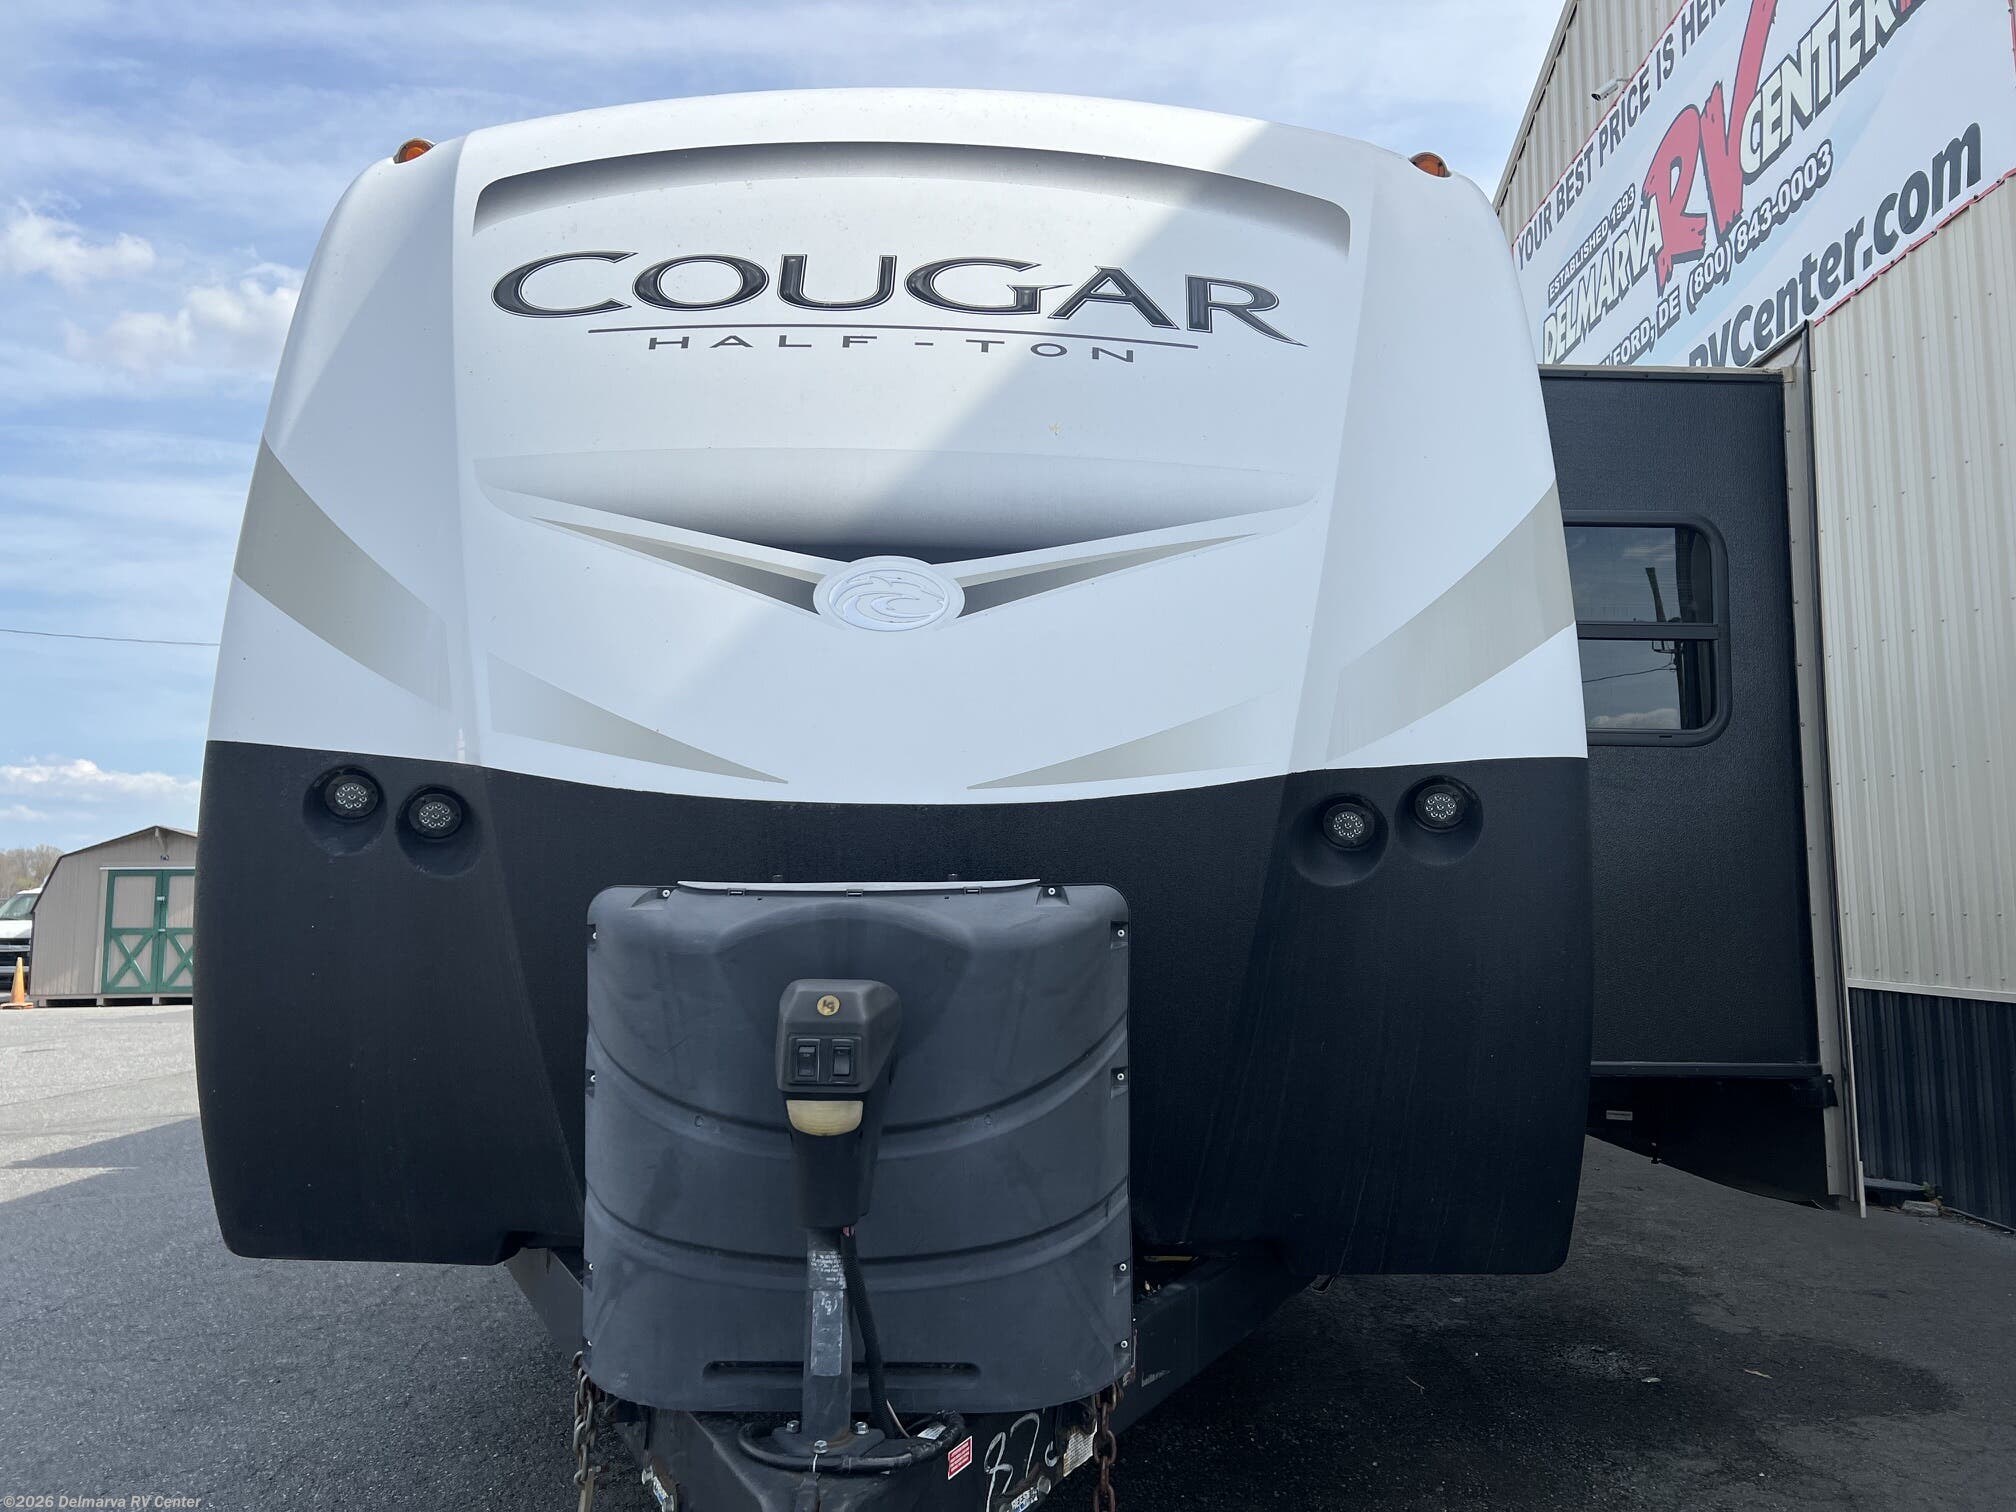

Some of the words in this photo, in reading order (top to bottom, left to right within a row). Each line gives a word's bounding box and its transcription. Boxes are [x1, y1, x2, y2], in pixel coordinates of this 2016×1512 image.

[1517, 201, 1553, 270] YOUR
[1556, 142, 1594, 224] BEST
[1599, 64, 1651, 168] PRICE
[1656, 33, 1675, 91] IS
[1543, 197, 1664, 366] DELMARVA
[1641, 0, 1778, 300] RV
[1548, 217, 1609, 305] ESTABLISHED
[1610, 183, 1636, 233] 1993
[1657, 286, 1681, 338] DE
[1686, 238, 1733, 313] (800)
[1734, 139, 1833, 264] 843-0003
[491, 250, 1308, 348] COUGAR
